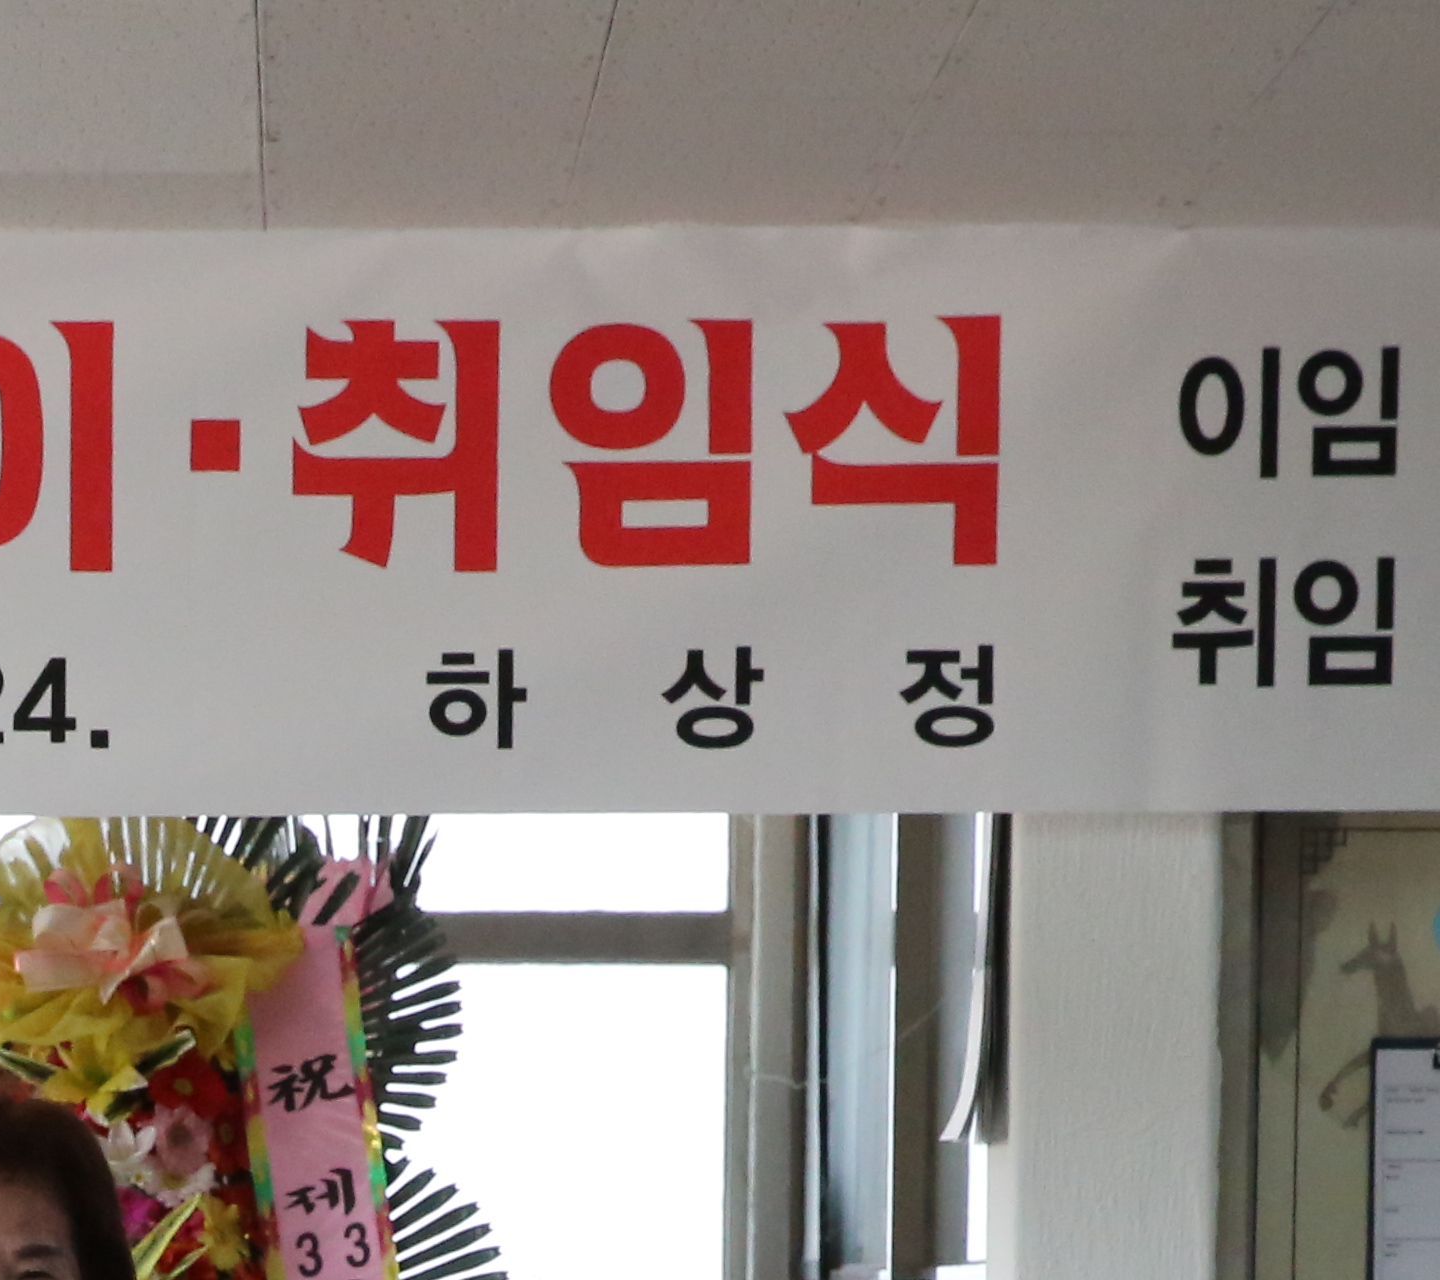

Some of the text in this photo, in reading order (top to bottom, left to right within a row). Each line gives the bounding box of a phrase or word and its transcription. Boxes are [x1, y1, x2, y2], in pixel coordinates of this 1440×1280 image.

[1178, 346, 1400, 479] 이임
[1172, 556, 1395, 688] 취임
[267, 1053, 356, 1113] 祝
